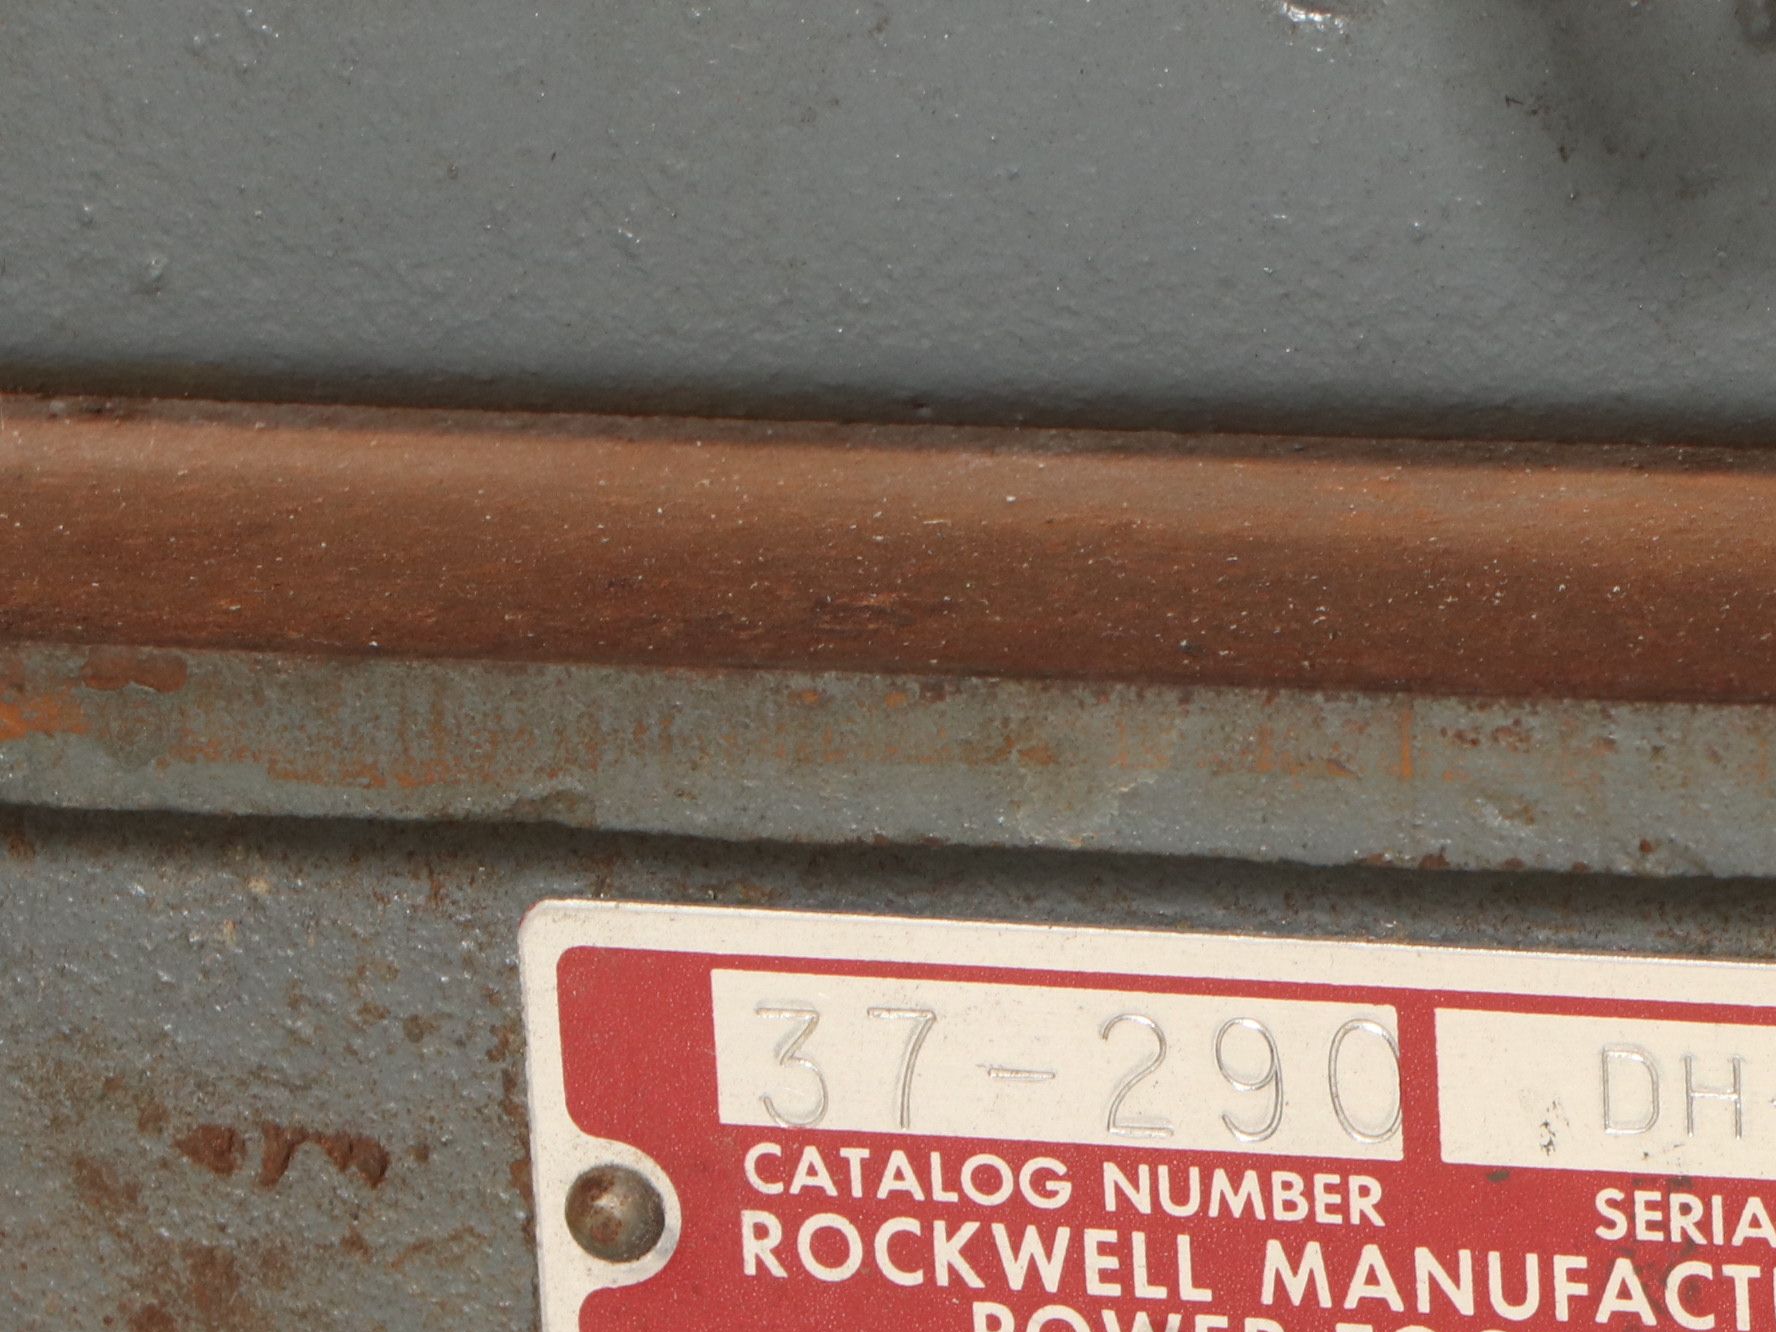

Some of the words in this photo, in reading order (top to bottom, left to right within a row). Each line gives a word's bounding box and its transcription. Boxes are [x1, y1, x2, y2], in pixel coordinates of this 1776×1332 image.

[753, 1000, 1404, 1145] 37-290
[743, 1142, 1073, 1210] CATALOG
[1102, 1161, 1386, 1227] NUMBER
[740, 1208, 1213, 1303] ROCKWELL
